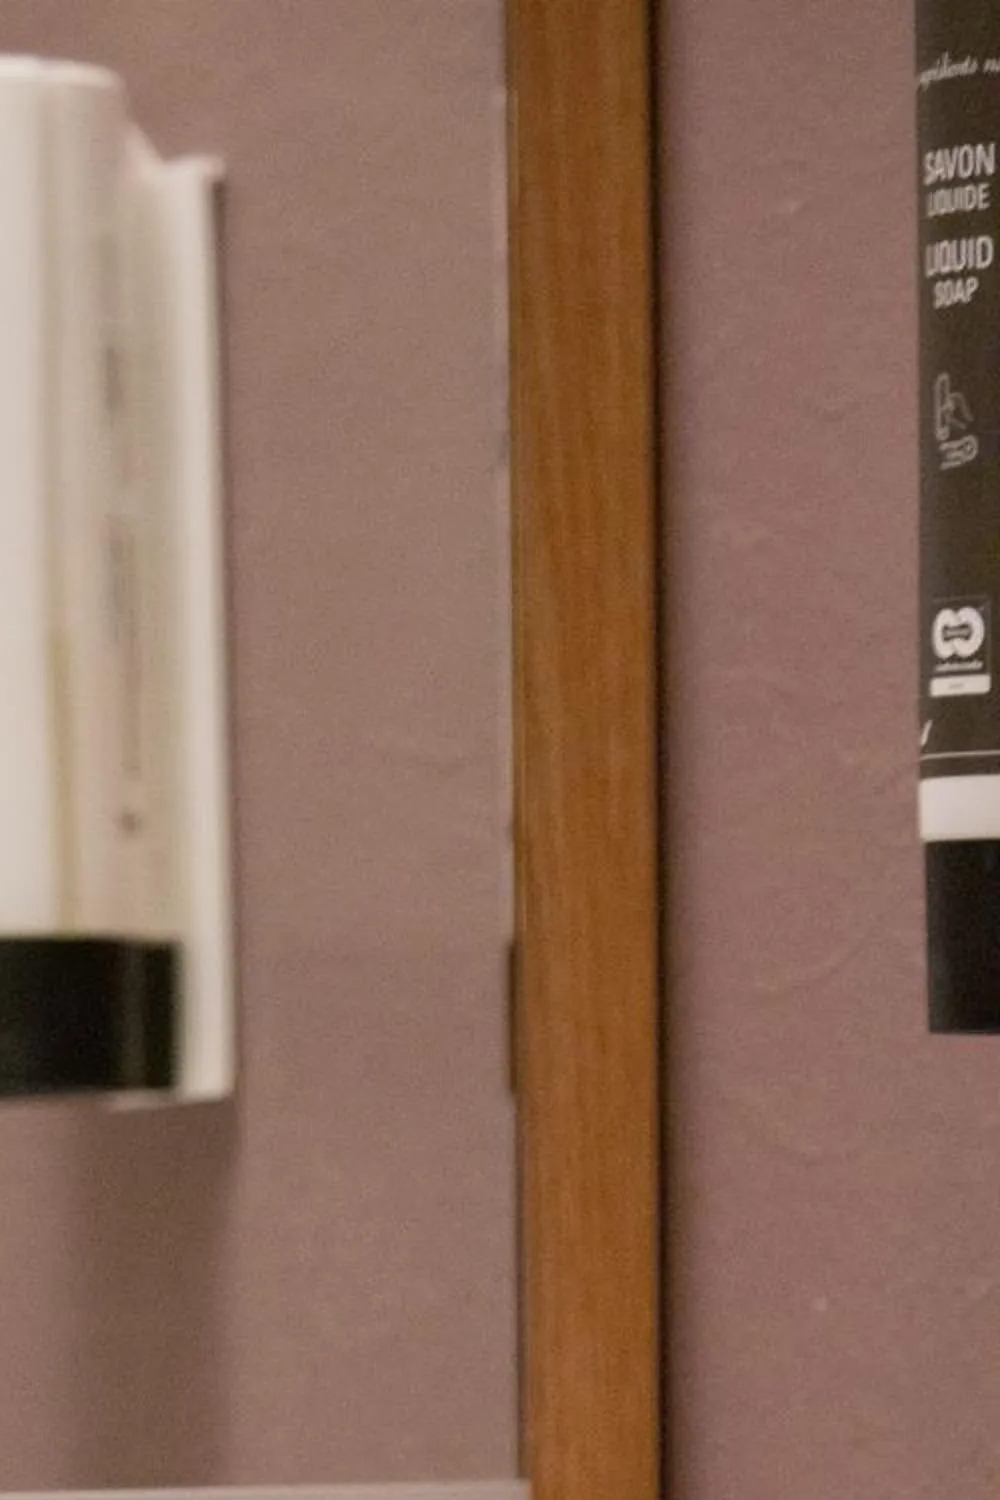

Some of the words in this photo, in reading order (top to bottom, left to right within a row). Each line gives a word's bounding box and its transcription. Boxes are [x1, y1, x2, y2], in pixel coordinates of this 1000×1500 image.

[923, 142, 996, 186] SAVON
[926, 182, 991, 217] LIQUIDE
[925, 234, 994, 278] LIQUID
[933, 275, 979, 309] SOAP
